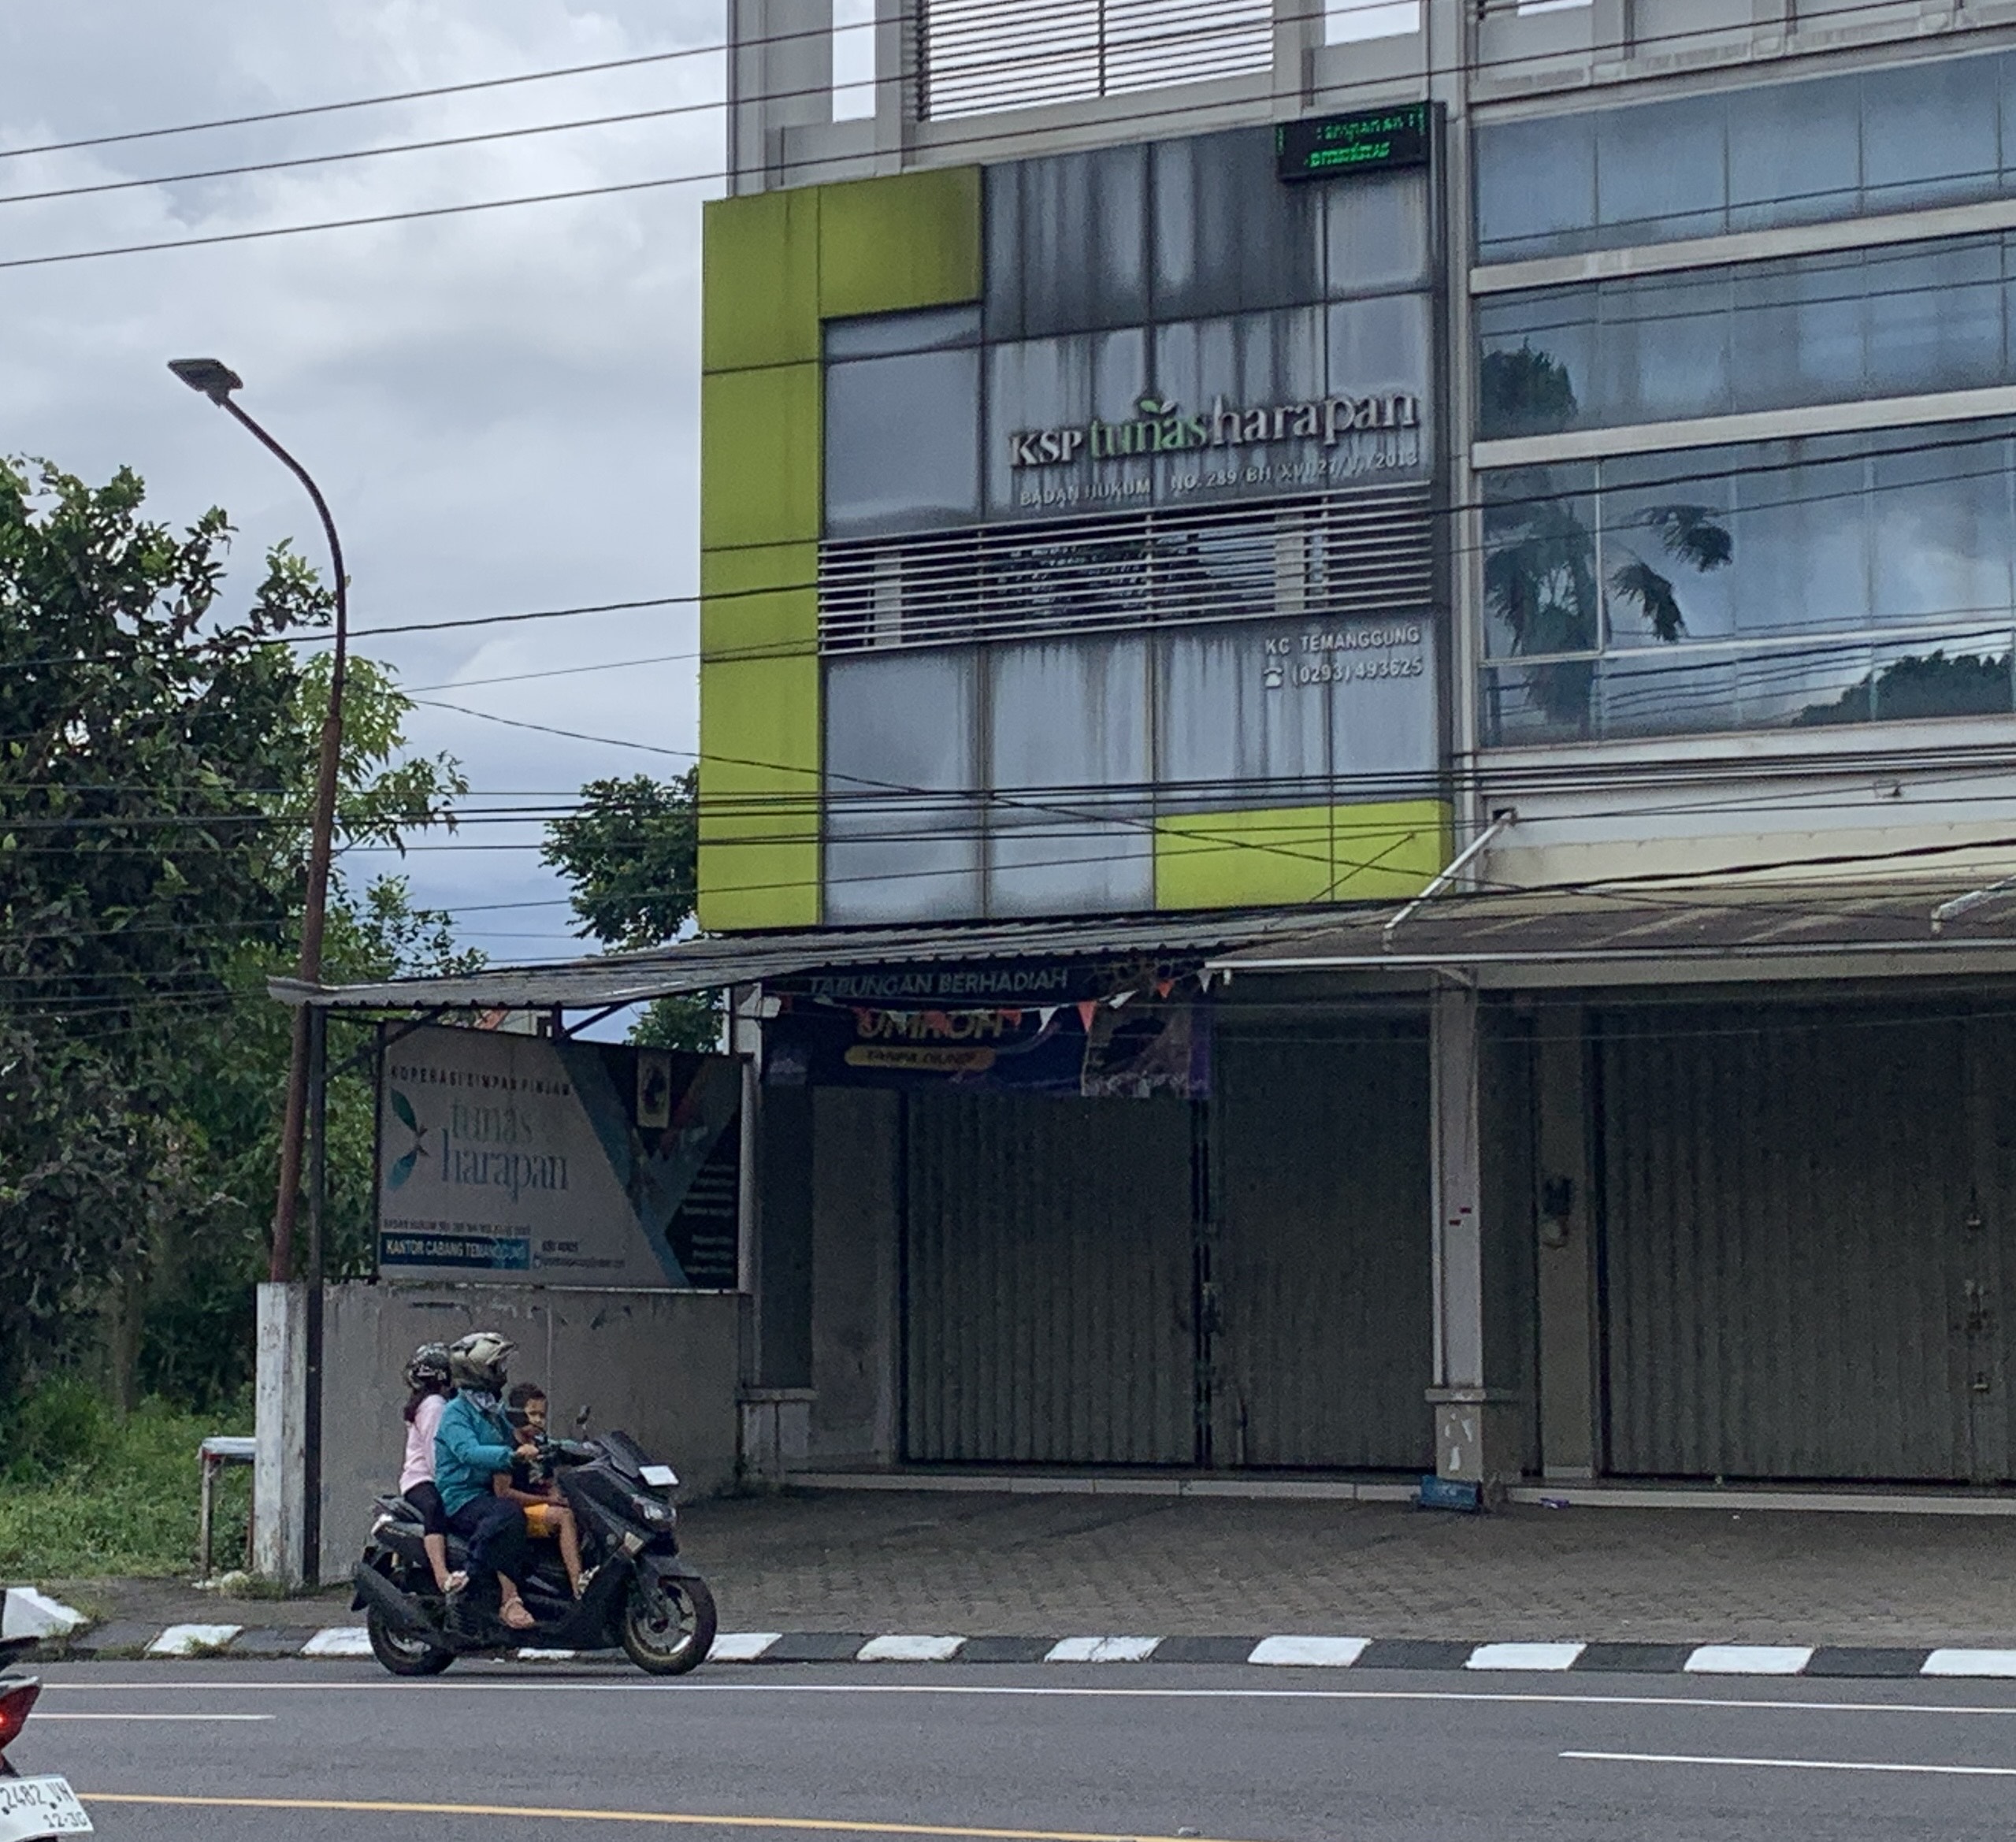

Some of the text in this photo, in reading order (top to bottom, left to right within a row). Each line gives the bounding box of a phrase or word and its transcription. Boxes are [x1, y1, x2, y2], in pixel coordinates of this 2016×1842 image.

[1009, 430, 1082, 466] KSP
[1020, 485, 1079, 507] BADAN
[1085, 478, 1151, 499] HUKUM
[1264, 626, 1420, 655] KC TEMANGGUNG
[809, 967, 1069, 997] TABUNGAN BERHADIAH
[390, 1065, 462, 1086] KOPERASI
[451, 1096, 533, 1143] tunas
[440, 1127, 570, 1204] harapan
[385, 1239, 425, 1256] KANTOR
[425, 1240, 463, 1257] CABANG
